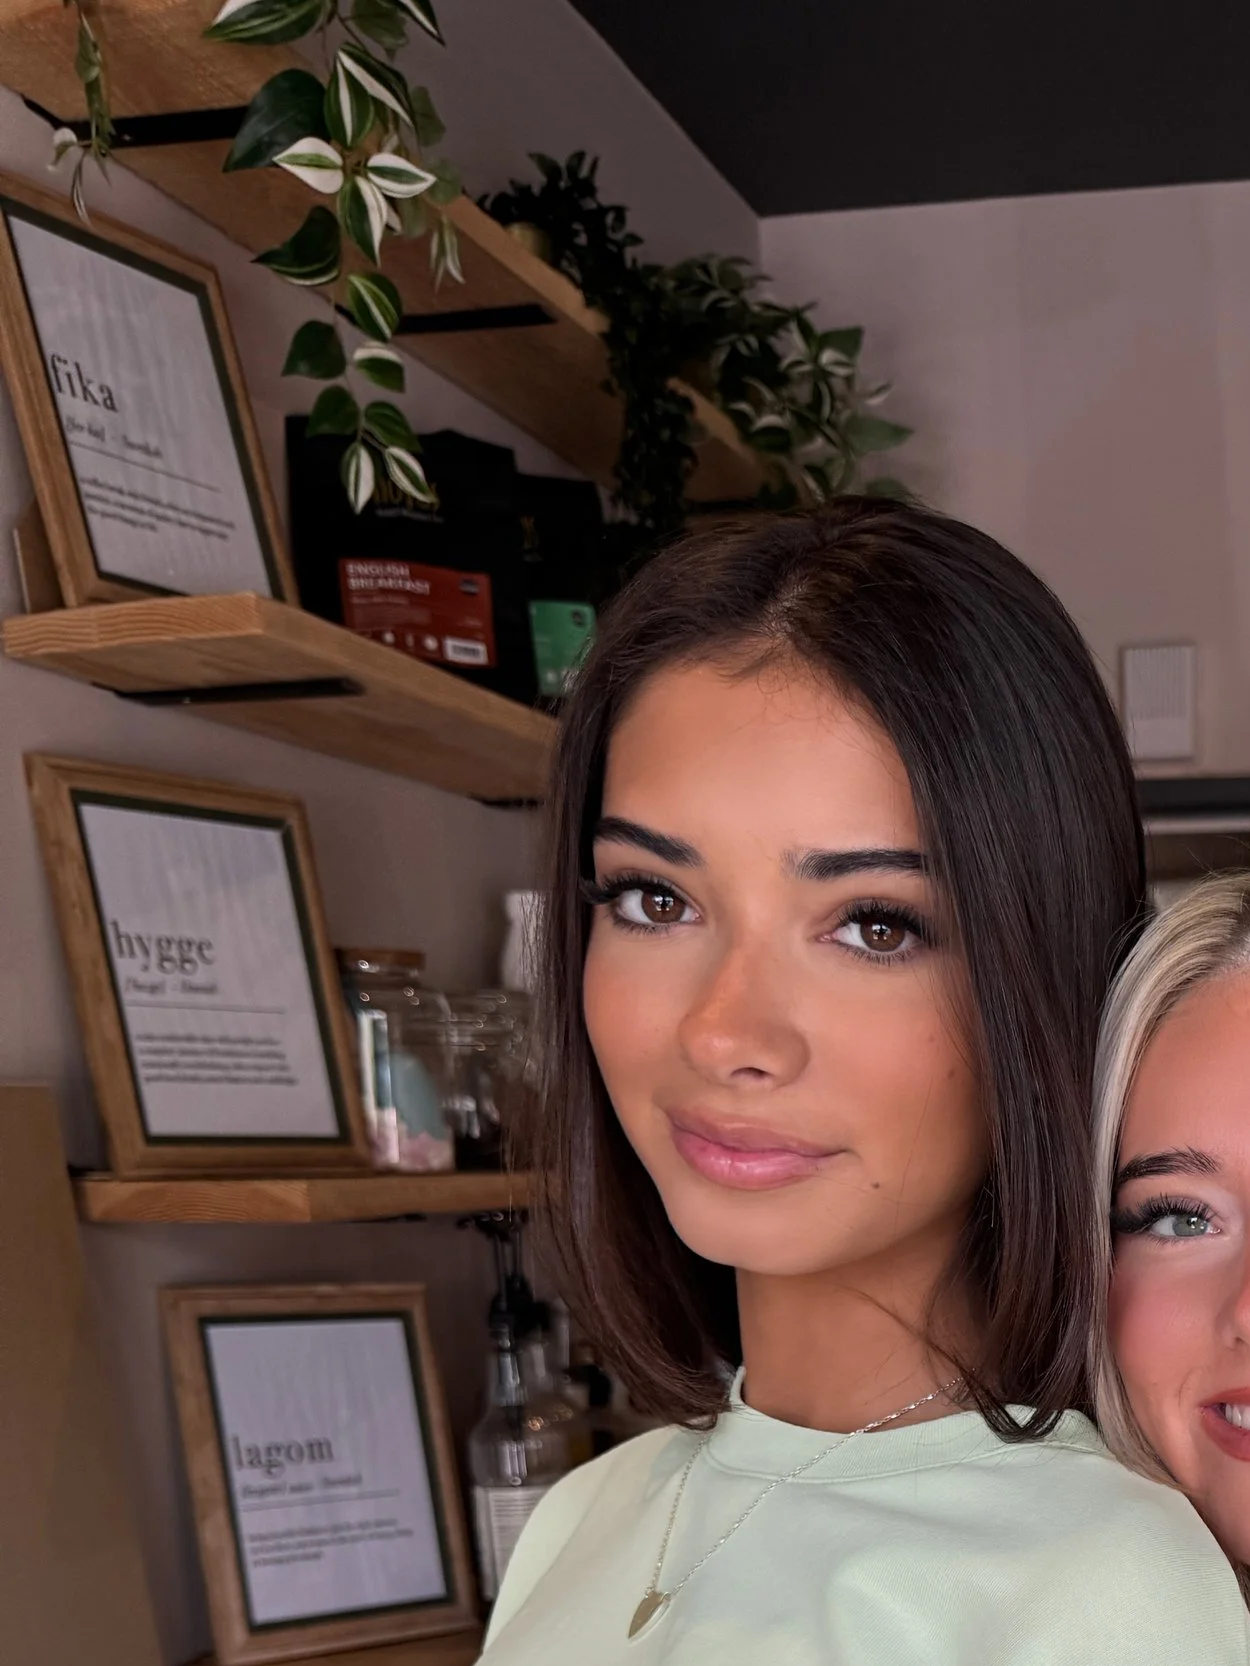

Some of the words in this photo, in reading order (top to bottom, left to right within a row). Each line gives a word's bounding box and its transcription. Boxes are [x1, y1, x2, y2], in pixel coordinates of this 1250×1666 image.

[50, 352, 119, 413] fika
[111, 919, 215, 976] hygge
[231, 1433, 336, 1479] lagom
